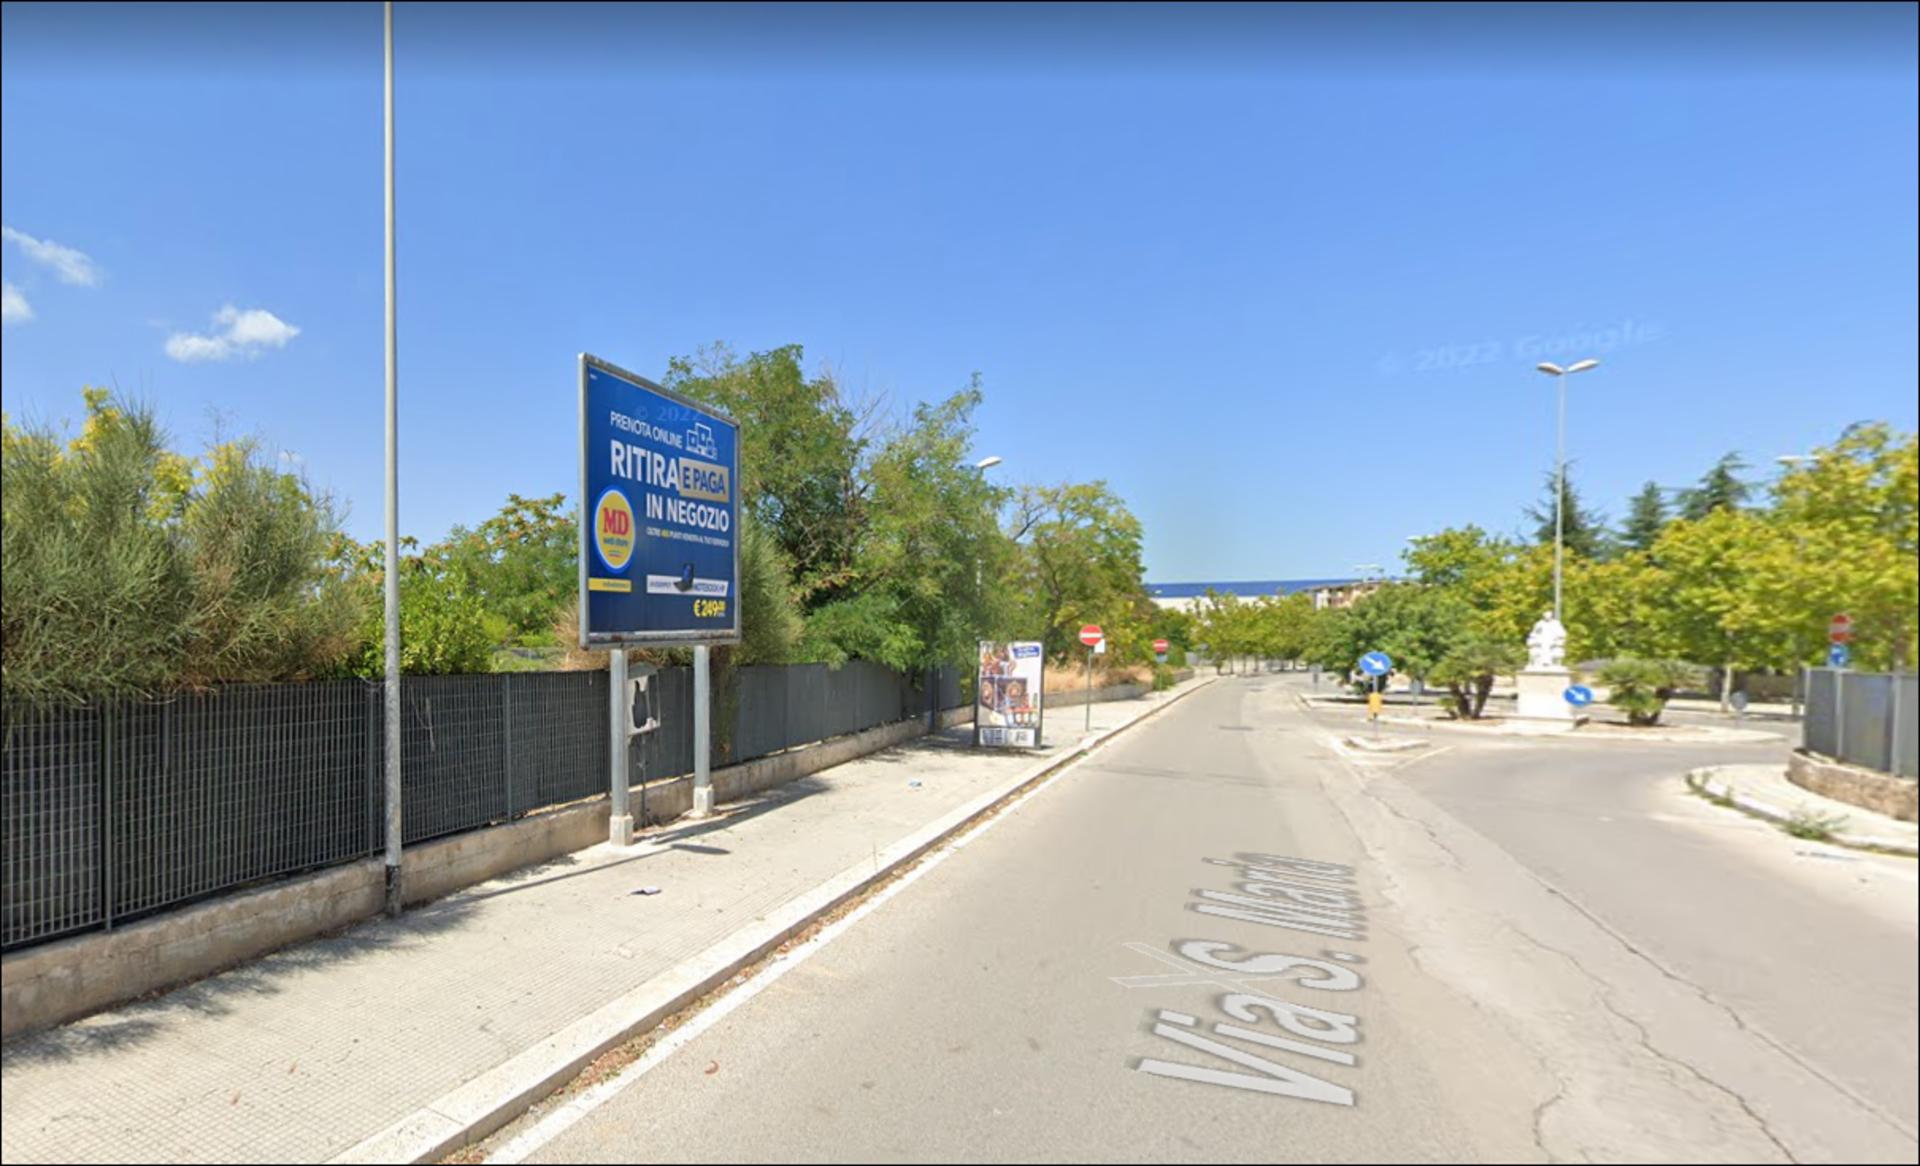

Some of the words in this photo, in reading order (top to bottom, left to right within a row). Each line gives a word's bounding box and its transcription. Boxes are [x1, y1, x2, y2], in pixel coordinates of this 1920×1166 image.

[610, 411, 652, 439] PRENOTA
[652, 426, 683, 448] ONLINE
[610, 439, 680, 491] RITIRA
[682, 466, 692, 490] E
[693, 469, 726, 495] PAGA
[602, 507, 630, 535] MD
[645, 492, 664, 520] IN
[666, 497, 729, 533] NEGOZIO
